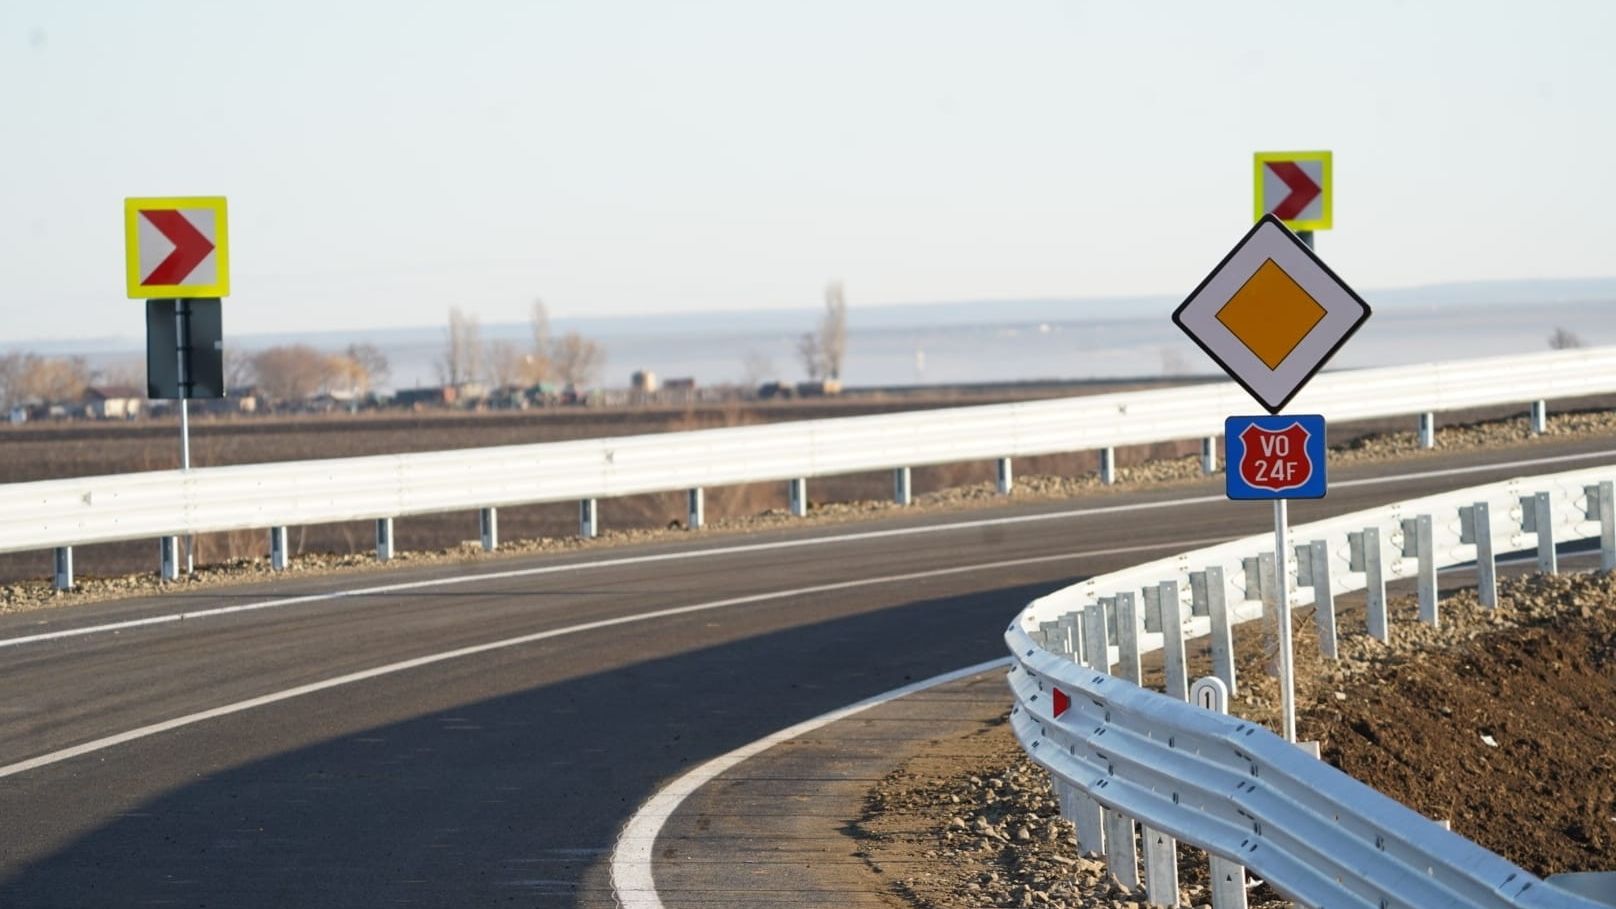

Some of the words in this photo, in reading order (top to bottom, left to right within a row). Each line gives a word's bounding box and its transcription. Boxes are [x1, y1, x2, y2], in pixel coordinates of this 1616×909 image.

[1260, 435, 1289, 457] VO
[1254, 459, 1298, 481] 24F
[1204, 691, 1210, 709] 1
